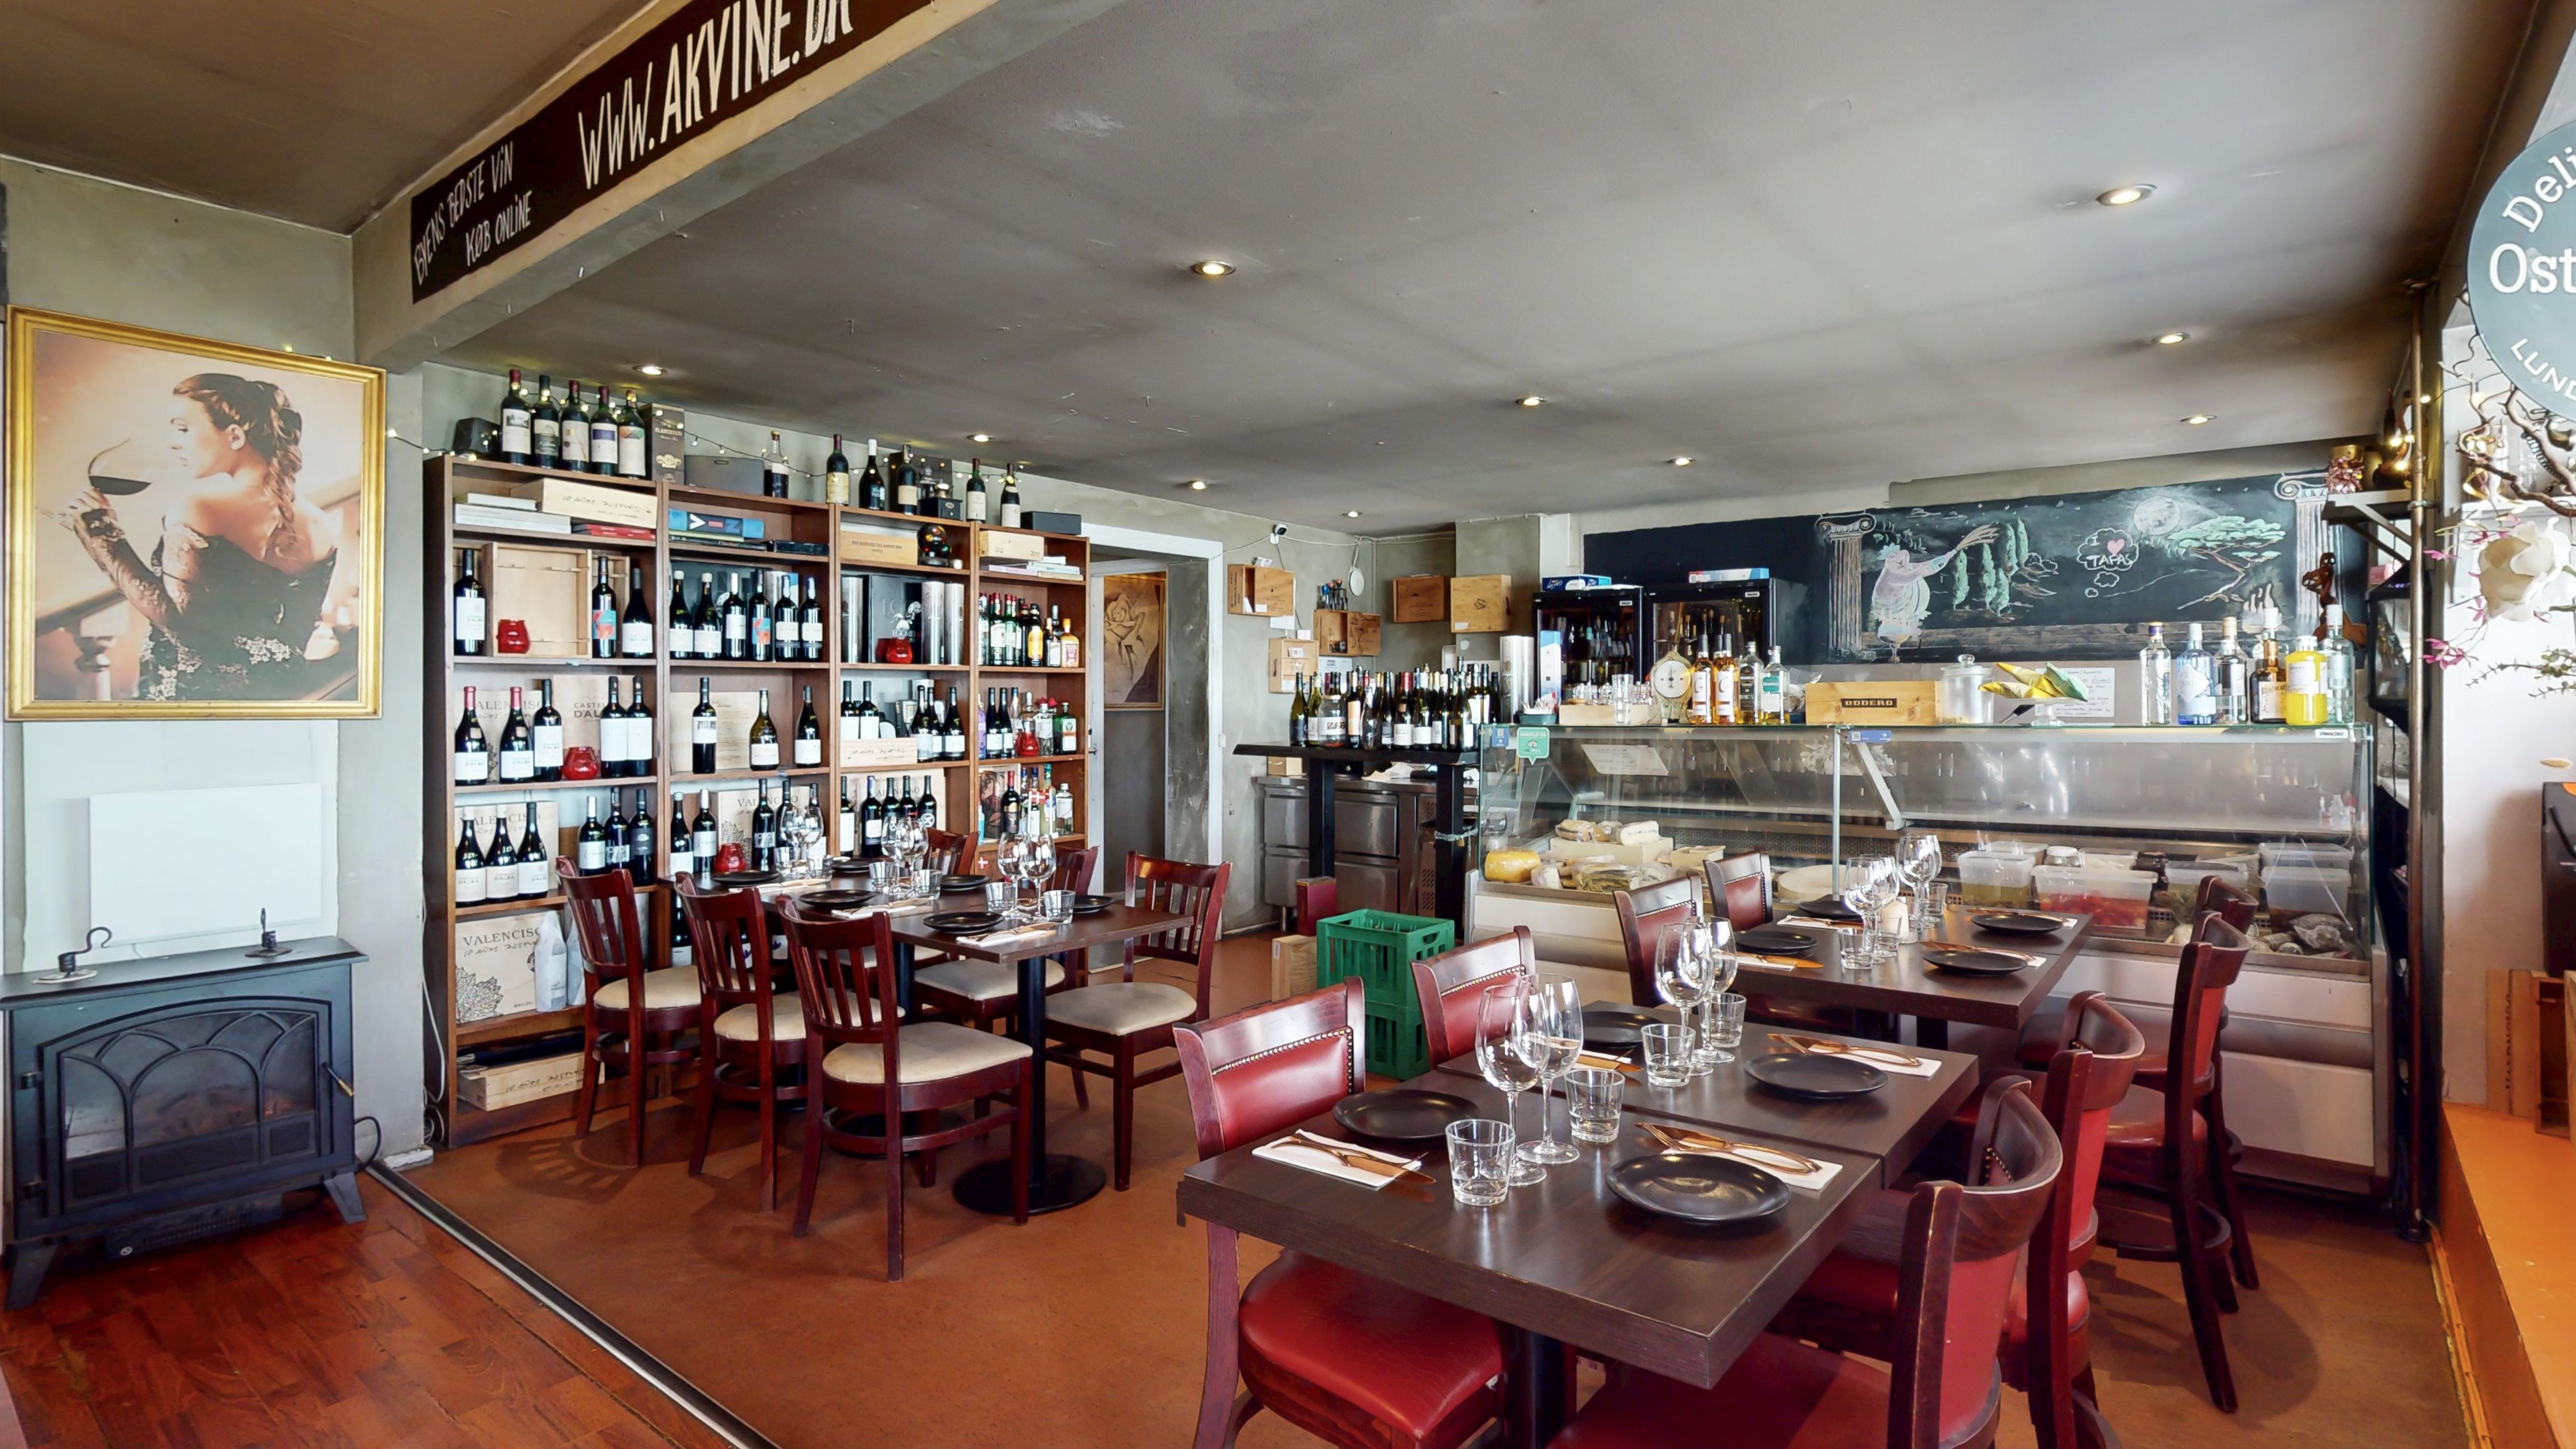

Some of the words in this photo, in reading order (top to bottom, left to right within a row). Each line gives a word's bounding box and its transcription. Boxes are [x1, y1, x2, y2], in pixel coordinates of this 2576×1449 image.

[414, 202, 446, 285] BYENS
[447, 159, 485, 228] BEDSTE
[466, 220, 491, 267] KØB
[2489, 243, 2576, 294] Ost
[2086, 554, 2133, 567] TAPAS
